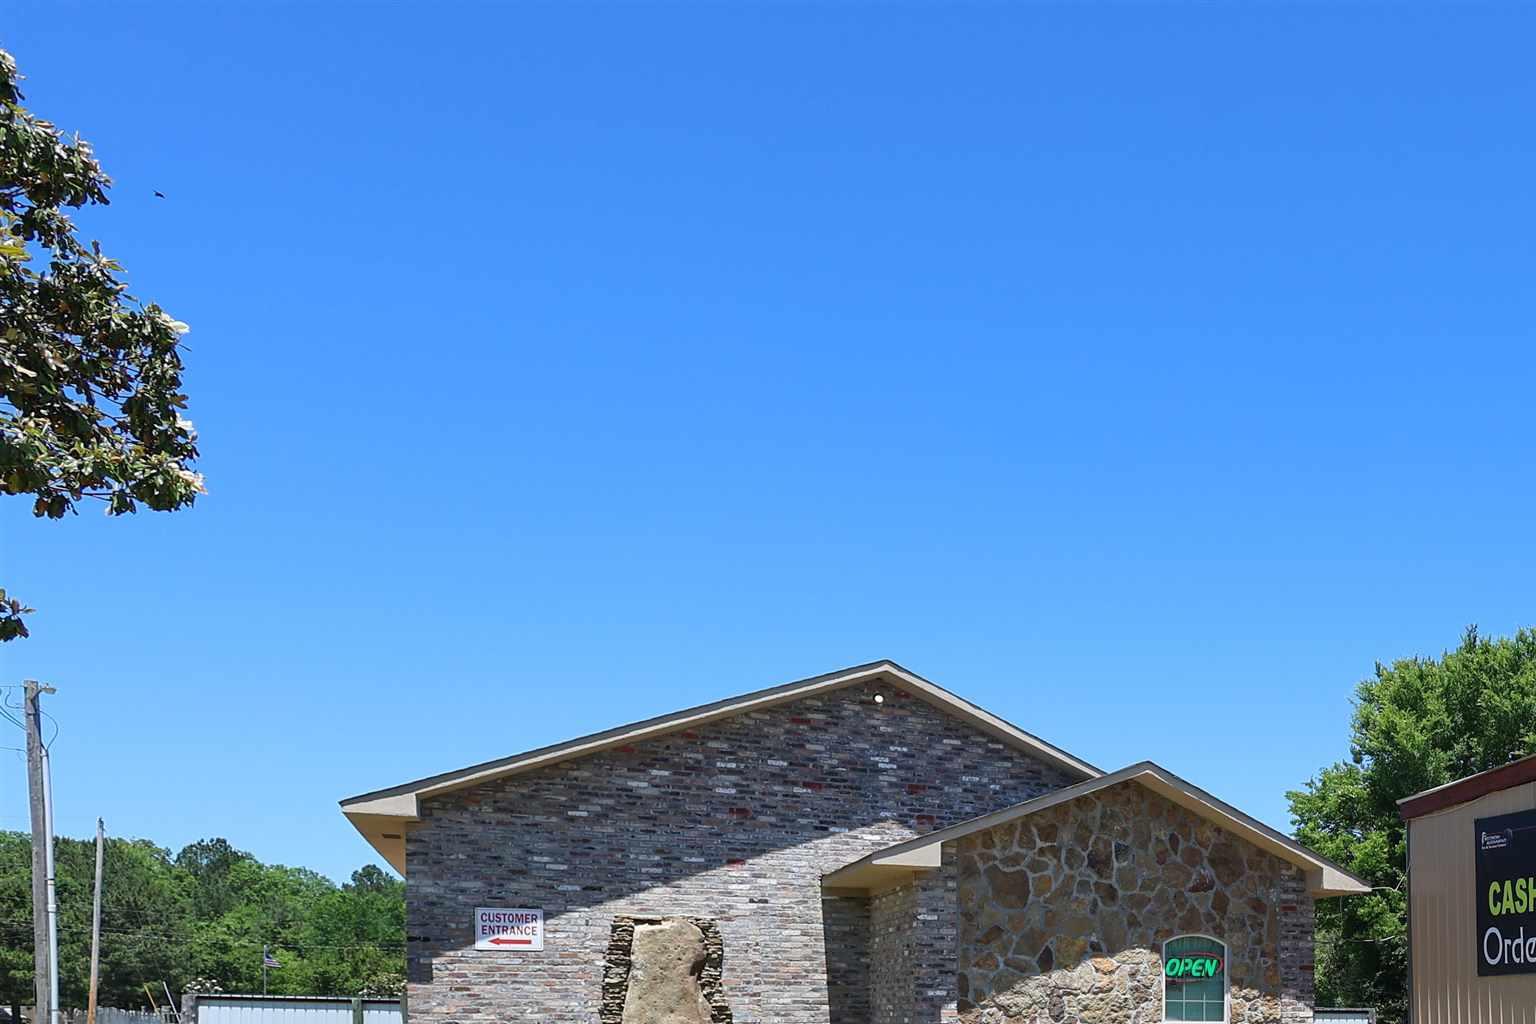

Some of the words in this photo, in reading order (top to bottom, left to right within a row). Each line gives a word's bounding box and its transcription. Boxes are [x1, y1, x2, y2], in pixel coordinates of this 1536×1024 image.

[480, 912, 538, 924] CUSTOMER
[481, 925, 537, 936] ENTRANCE
[1165, 958, 1218, 977] OPEN
